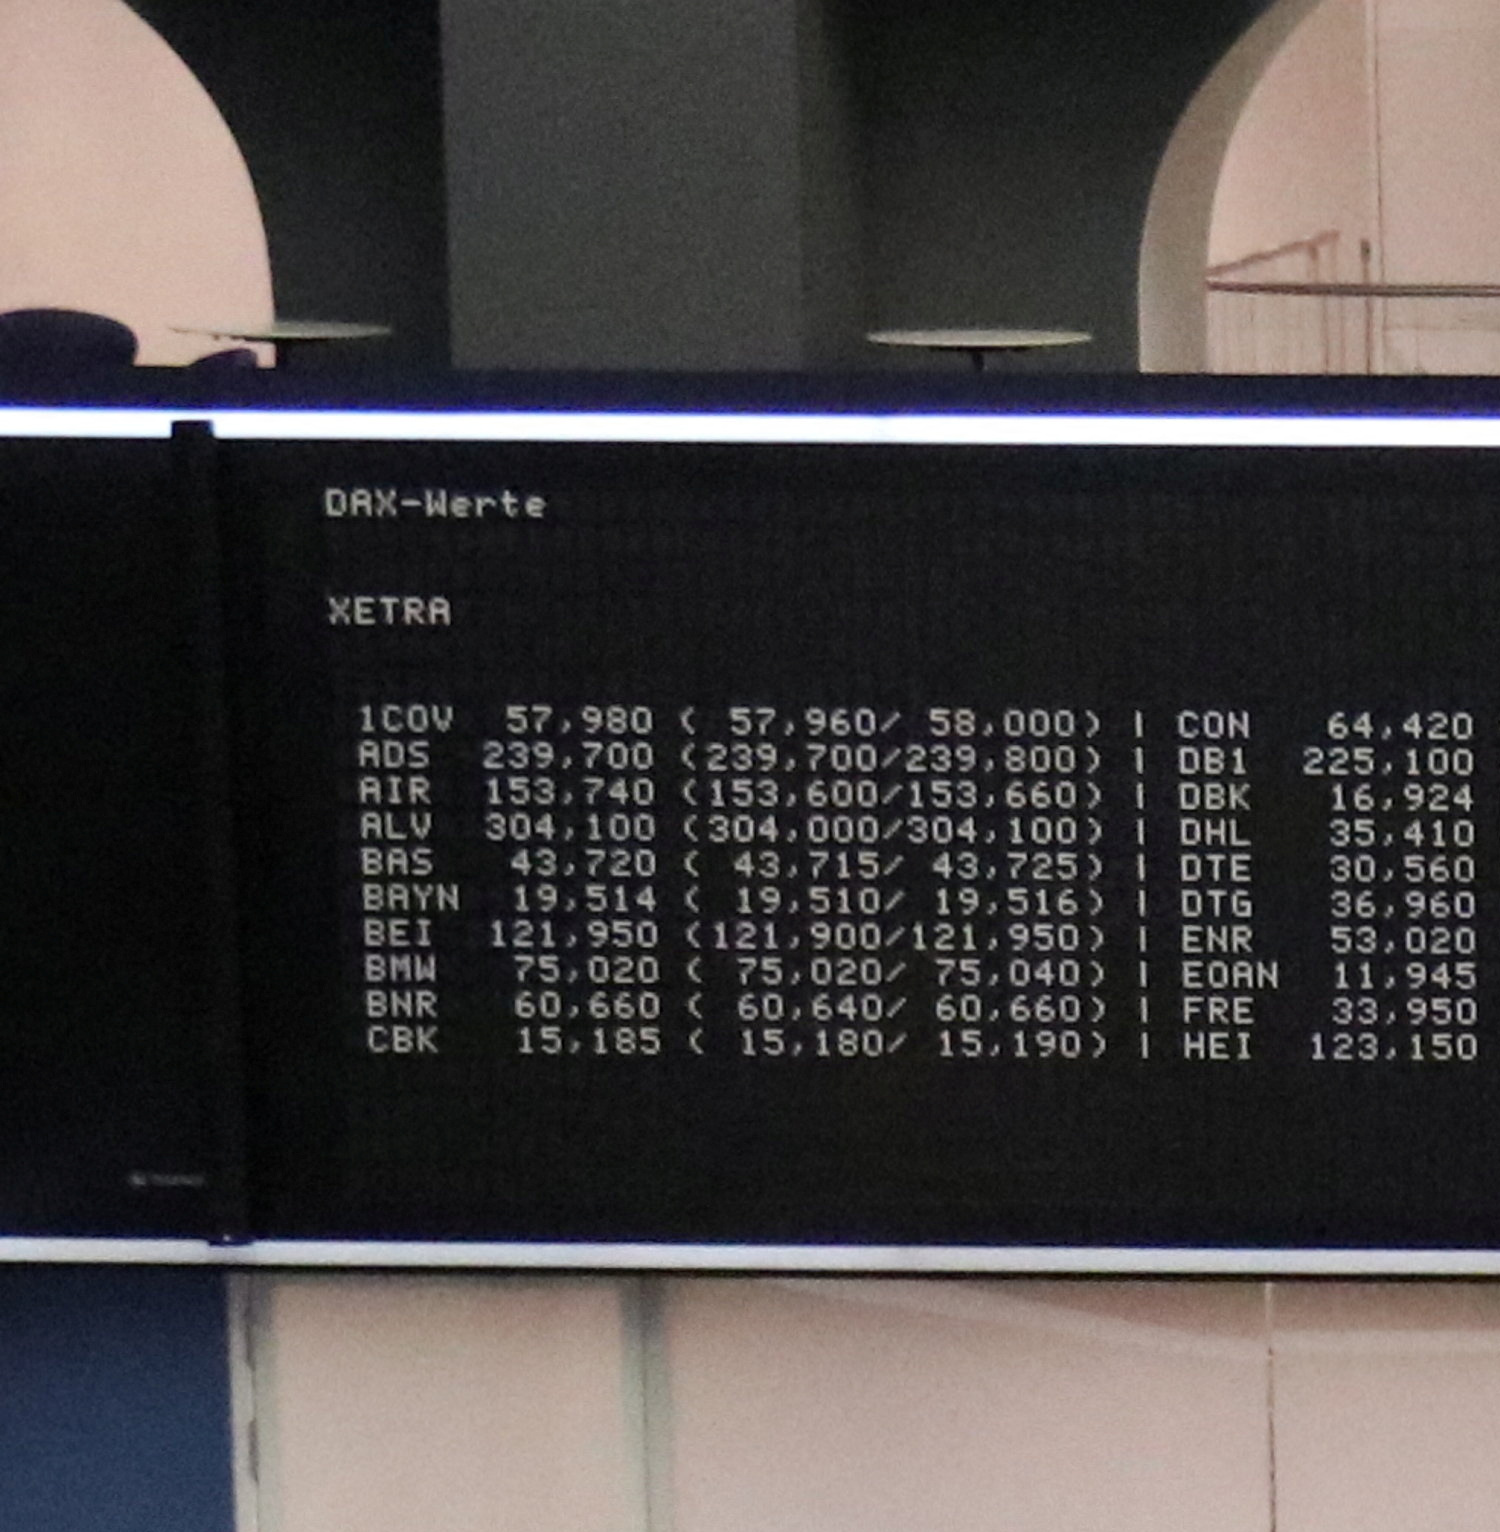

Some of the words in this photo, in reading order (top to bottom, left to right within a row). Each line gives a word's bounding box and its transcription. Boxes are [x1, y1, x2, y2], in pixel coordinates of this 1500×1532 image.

[324, 487, 546, 518] DAX-Werte
[328, 595, 451, 626] XETRA
[360, 703, 454, 733] 1COV
[506, 704, 653, 735] 57,980
[1177, 709, 1250, 739] CON
[1327, 711, 1473, 741] 64,420
[357, 739, 430, 769] ADS
[482, 740, 654, 771] 239,700
[1178, 745, 1246, 775] DB1
[1303, 746, 1474, 776] 225,100
[358, 775, 431, 805] AIR
[487, 776, 655, 806] 153,740
[1178, 781, 1251, 811] DBK
[1332, 782, 1474, 812] 16,924
[360, 811, 432, 840] ALV
[485, 811, 656, 842] 304,100
[1180, 817, 1252, 847] DHL
[1329, 818, 1475, 848] 35,410
[360, 846, 433, 876] BAS
[510, 847, 656, 877] 43,720
[1180, 853, 1252, 882] DTE
[1330, 853, 1475, 883] 30,560
[362, 882, 459, 911] BAYN
[514, 883, 657, 913] 19,514
[1181, 889, 1252, 918] DTG
[1330, 889, 1476, 919] 36,960
[363, 917, 431, 947] BEI
[491, 919, 658, 949] 121,950
[1181, 924, 1253, 954] ENR
[1330, 925, 1476, 955] 53,020
[364, 953, 436, 983] BMW
[513, 954, 660, 984] 75,020
[1181, 960, 1278, 989] EOAN
[1335, 961, 1477, 990] 11,945
[365, 989, 437, 1018] BNR
[514, 990, 660, 1020] 60,660
[1183, 995, 1254, 1025] FRE
[1332, 996, 1477, 1026] 33,950
[367, 1024, 439, 1054] CBK
[519, 1025, 661, 1056] 15,185
[1183, 1031, 1251, 1060] HEI
[1311, 1032, 1478, 1061] 123,150
